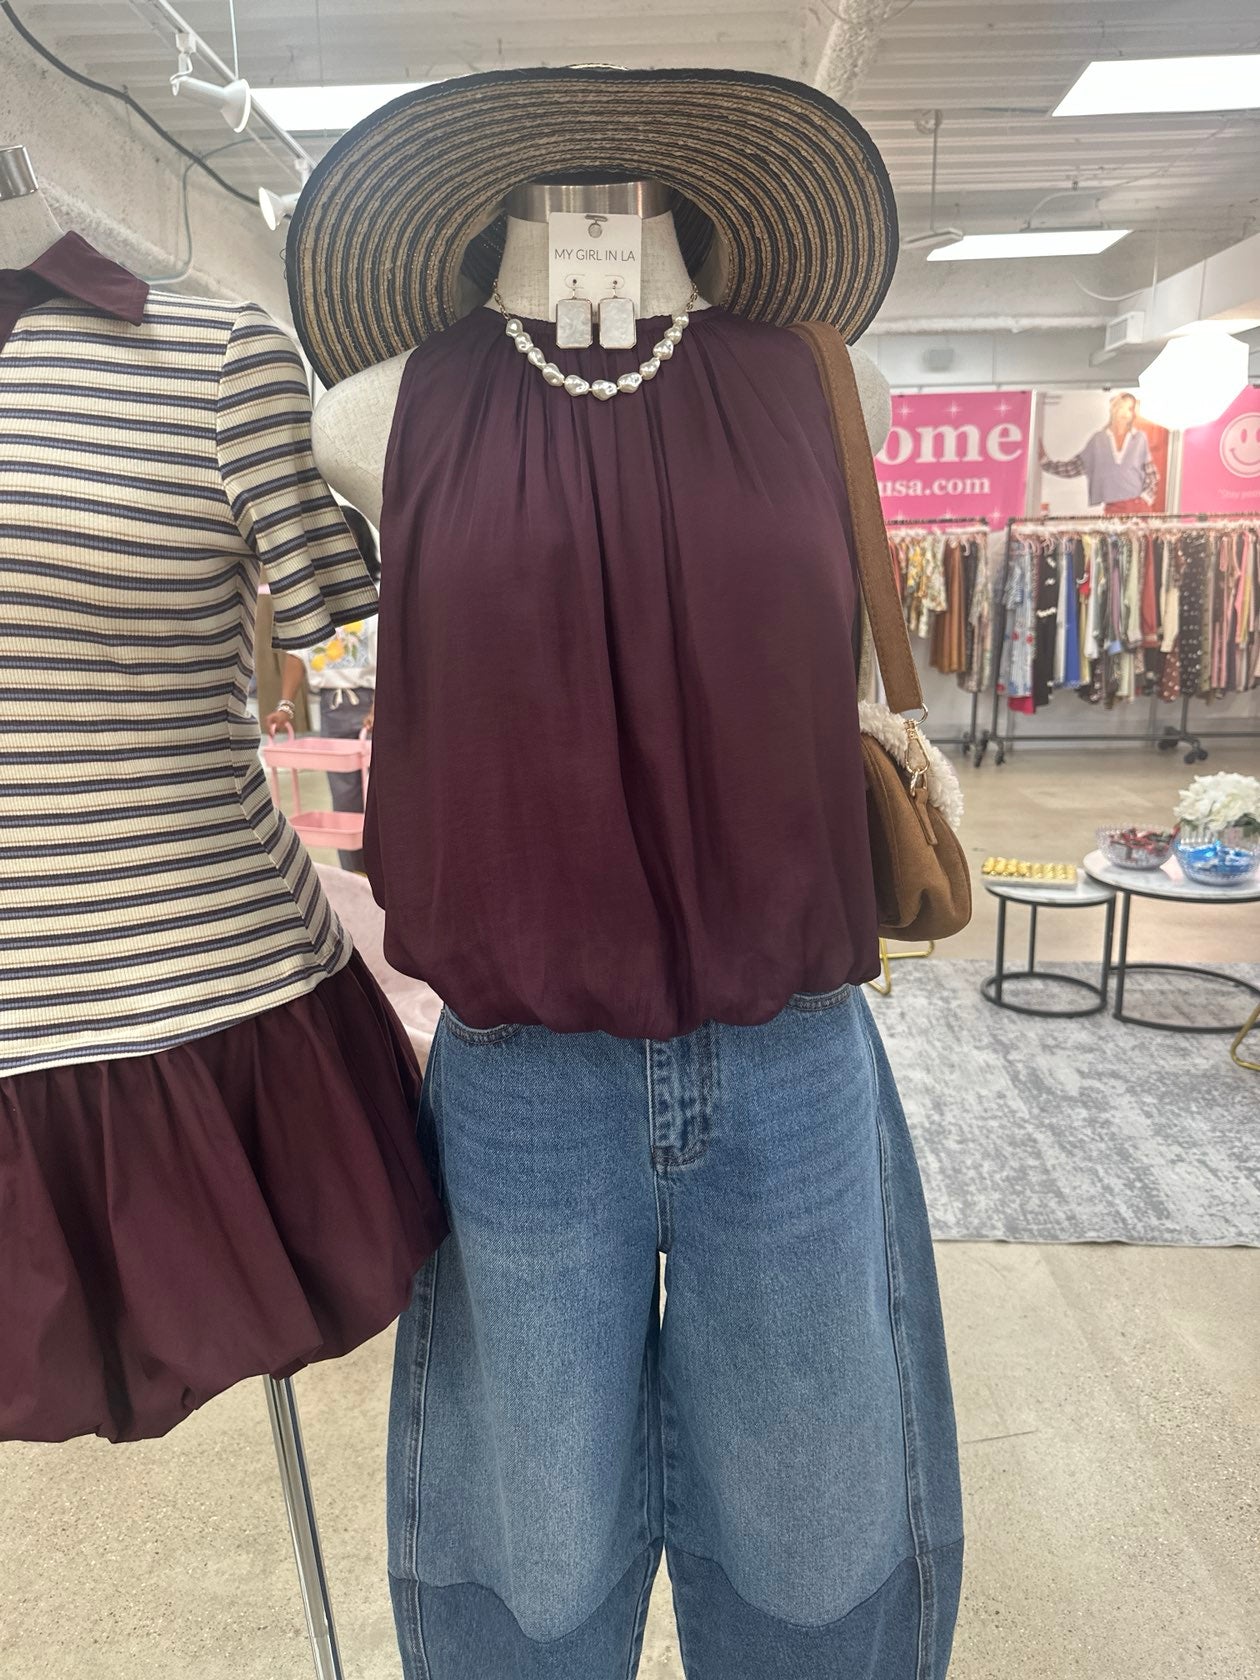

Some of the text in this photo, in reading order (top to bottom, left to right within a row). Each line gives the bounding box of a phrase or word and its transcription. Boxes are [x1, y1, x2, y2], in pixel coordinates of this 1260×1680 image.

[554, 248, 635, 262] MY GIRL IN LA
[875, 422, 1023, 465] ome
